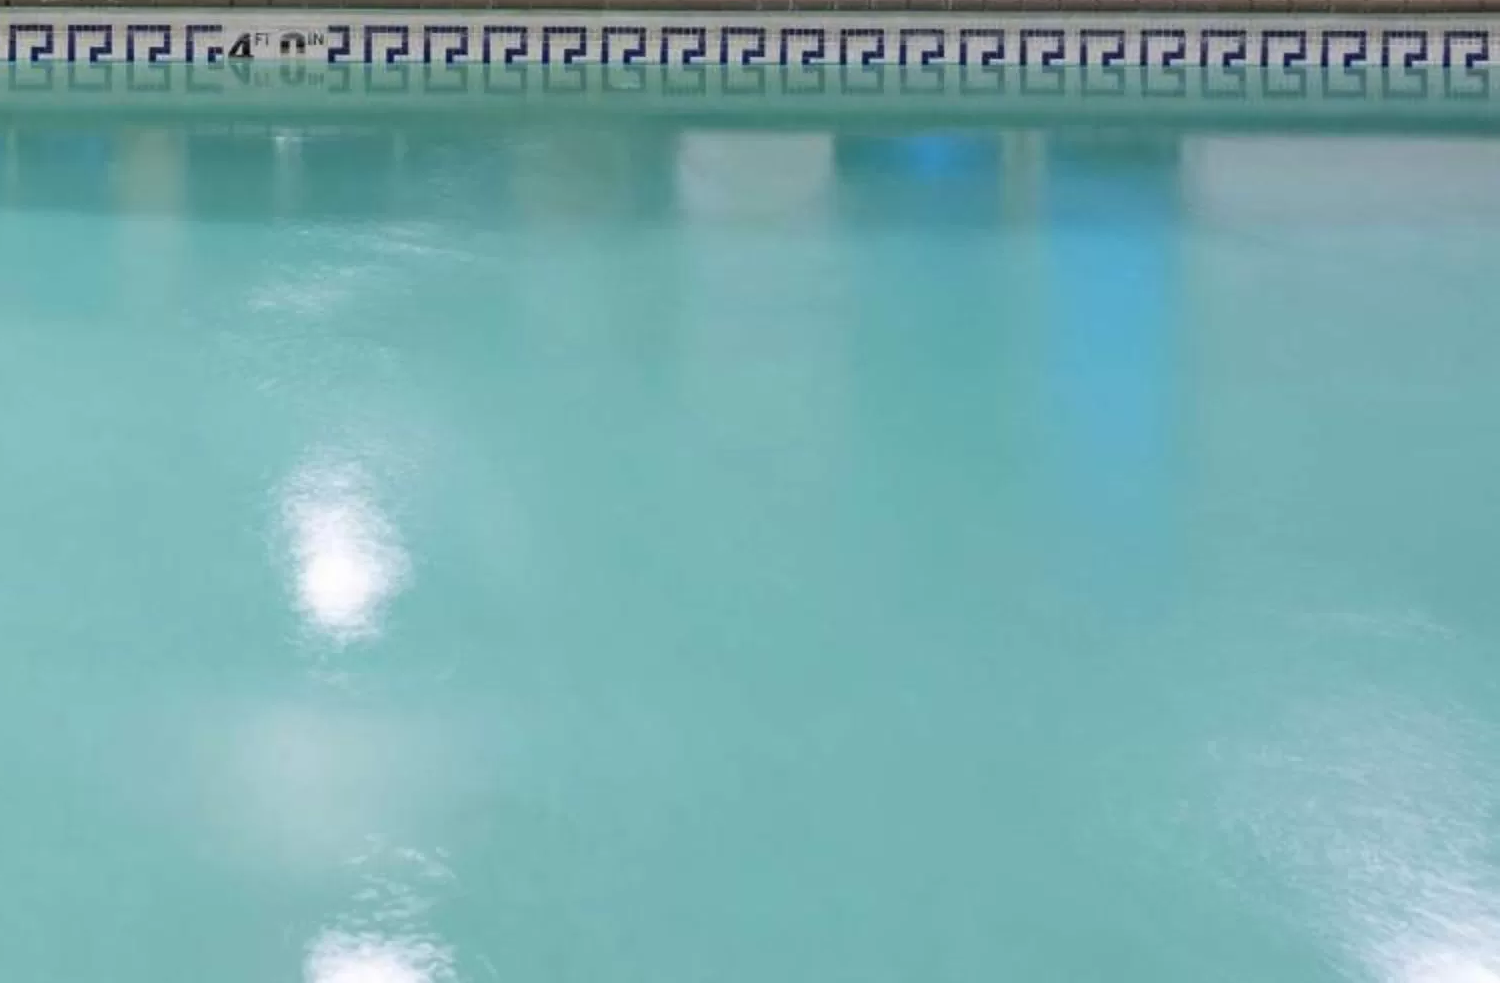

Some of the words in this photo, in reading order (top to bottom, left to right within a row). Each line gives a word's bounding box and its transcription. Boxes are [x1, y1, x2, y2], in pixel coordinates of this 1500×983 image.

[228, 32, 254, 57] 4
[255, 32, 269, 45] FT
[307, 31, 324, 45] IN
